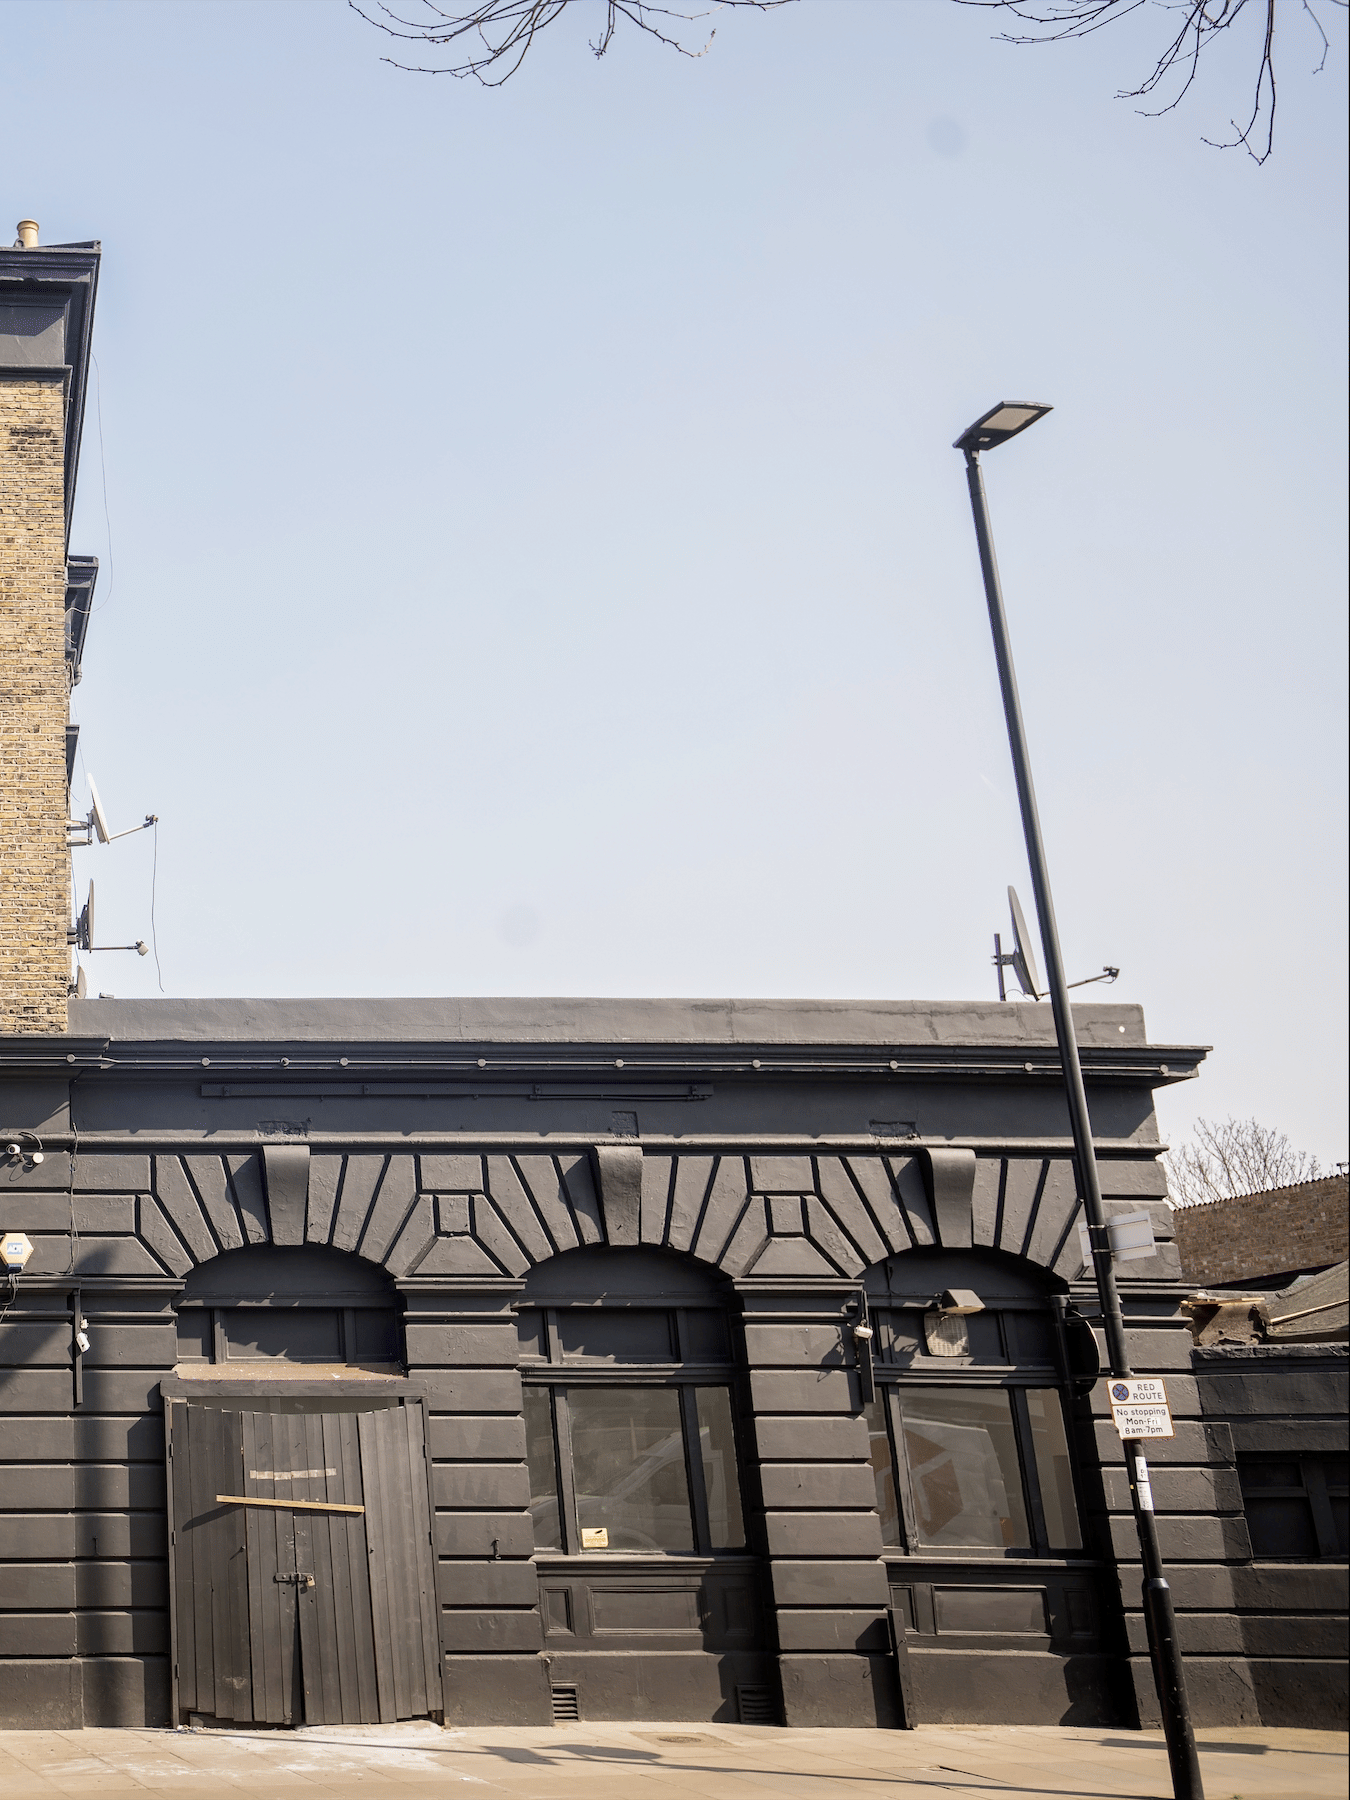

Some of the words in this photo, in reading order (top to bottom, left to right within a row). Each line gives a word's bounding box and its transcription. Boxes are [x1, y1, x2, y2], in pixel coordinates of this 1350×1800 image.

[1137, 1383, 1155, 1391] RED
[1133, 1392, 1163, 1400] ROUTE
[1131, 1408, 1166, 1416] stopping
